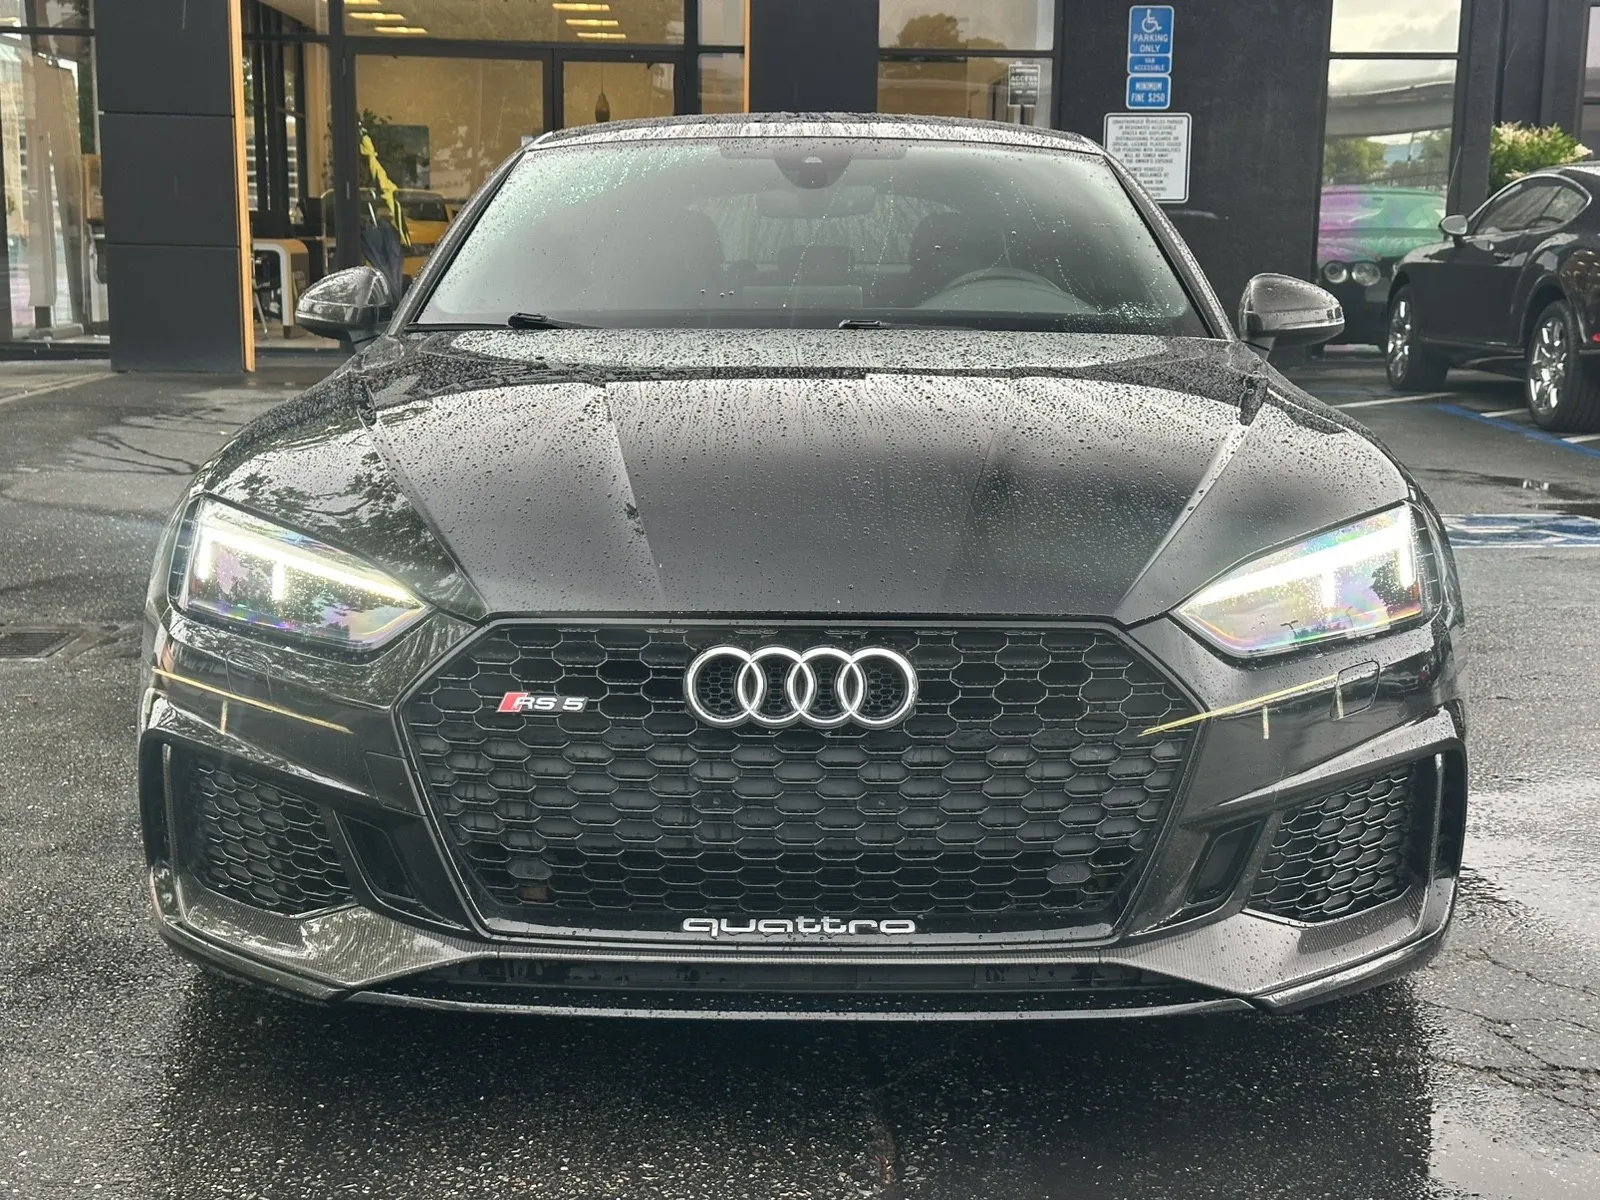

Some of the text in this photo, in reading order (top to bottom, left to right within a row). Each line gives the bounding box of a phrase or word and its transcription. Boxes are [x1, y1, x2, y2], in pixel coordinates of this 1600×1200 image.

[1132, 33, 1169, 42] PARKING
[1139, 43, 1161, 53] ONLY
[1135, 82, 1163, 91] MINIMUM
[1131, 92, 1166, 103] FINE $250
[511, 696, 586, 711] RS 5
[682, 915, 916, 938] quattro
